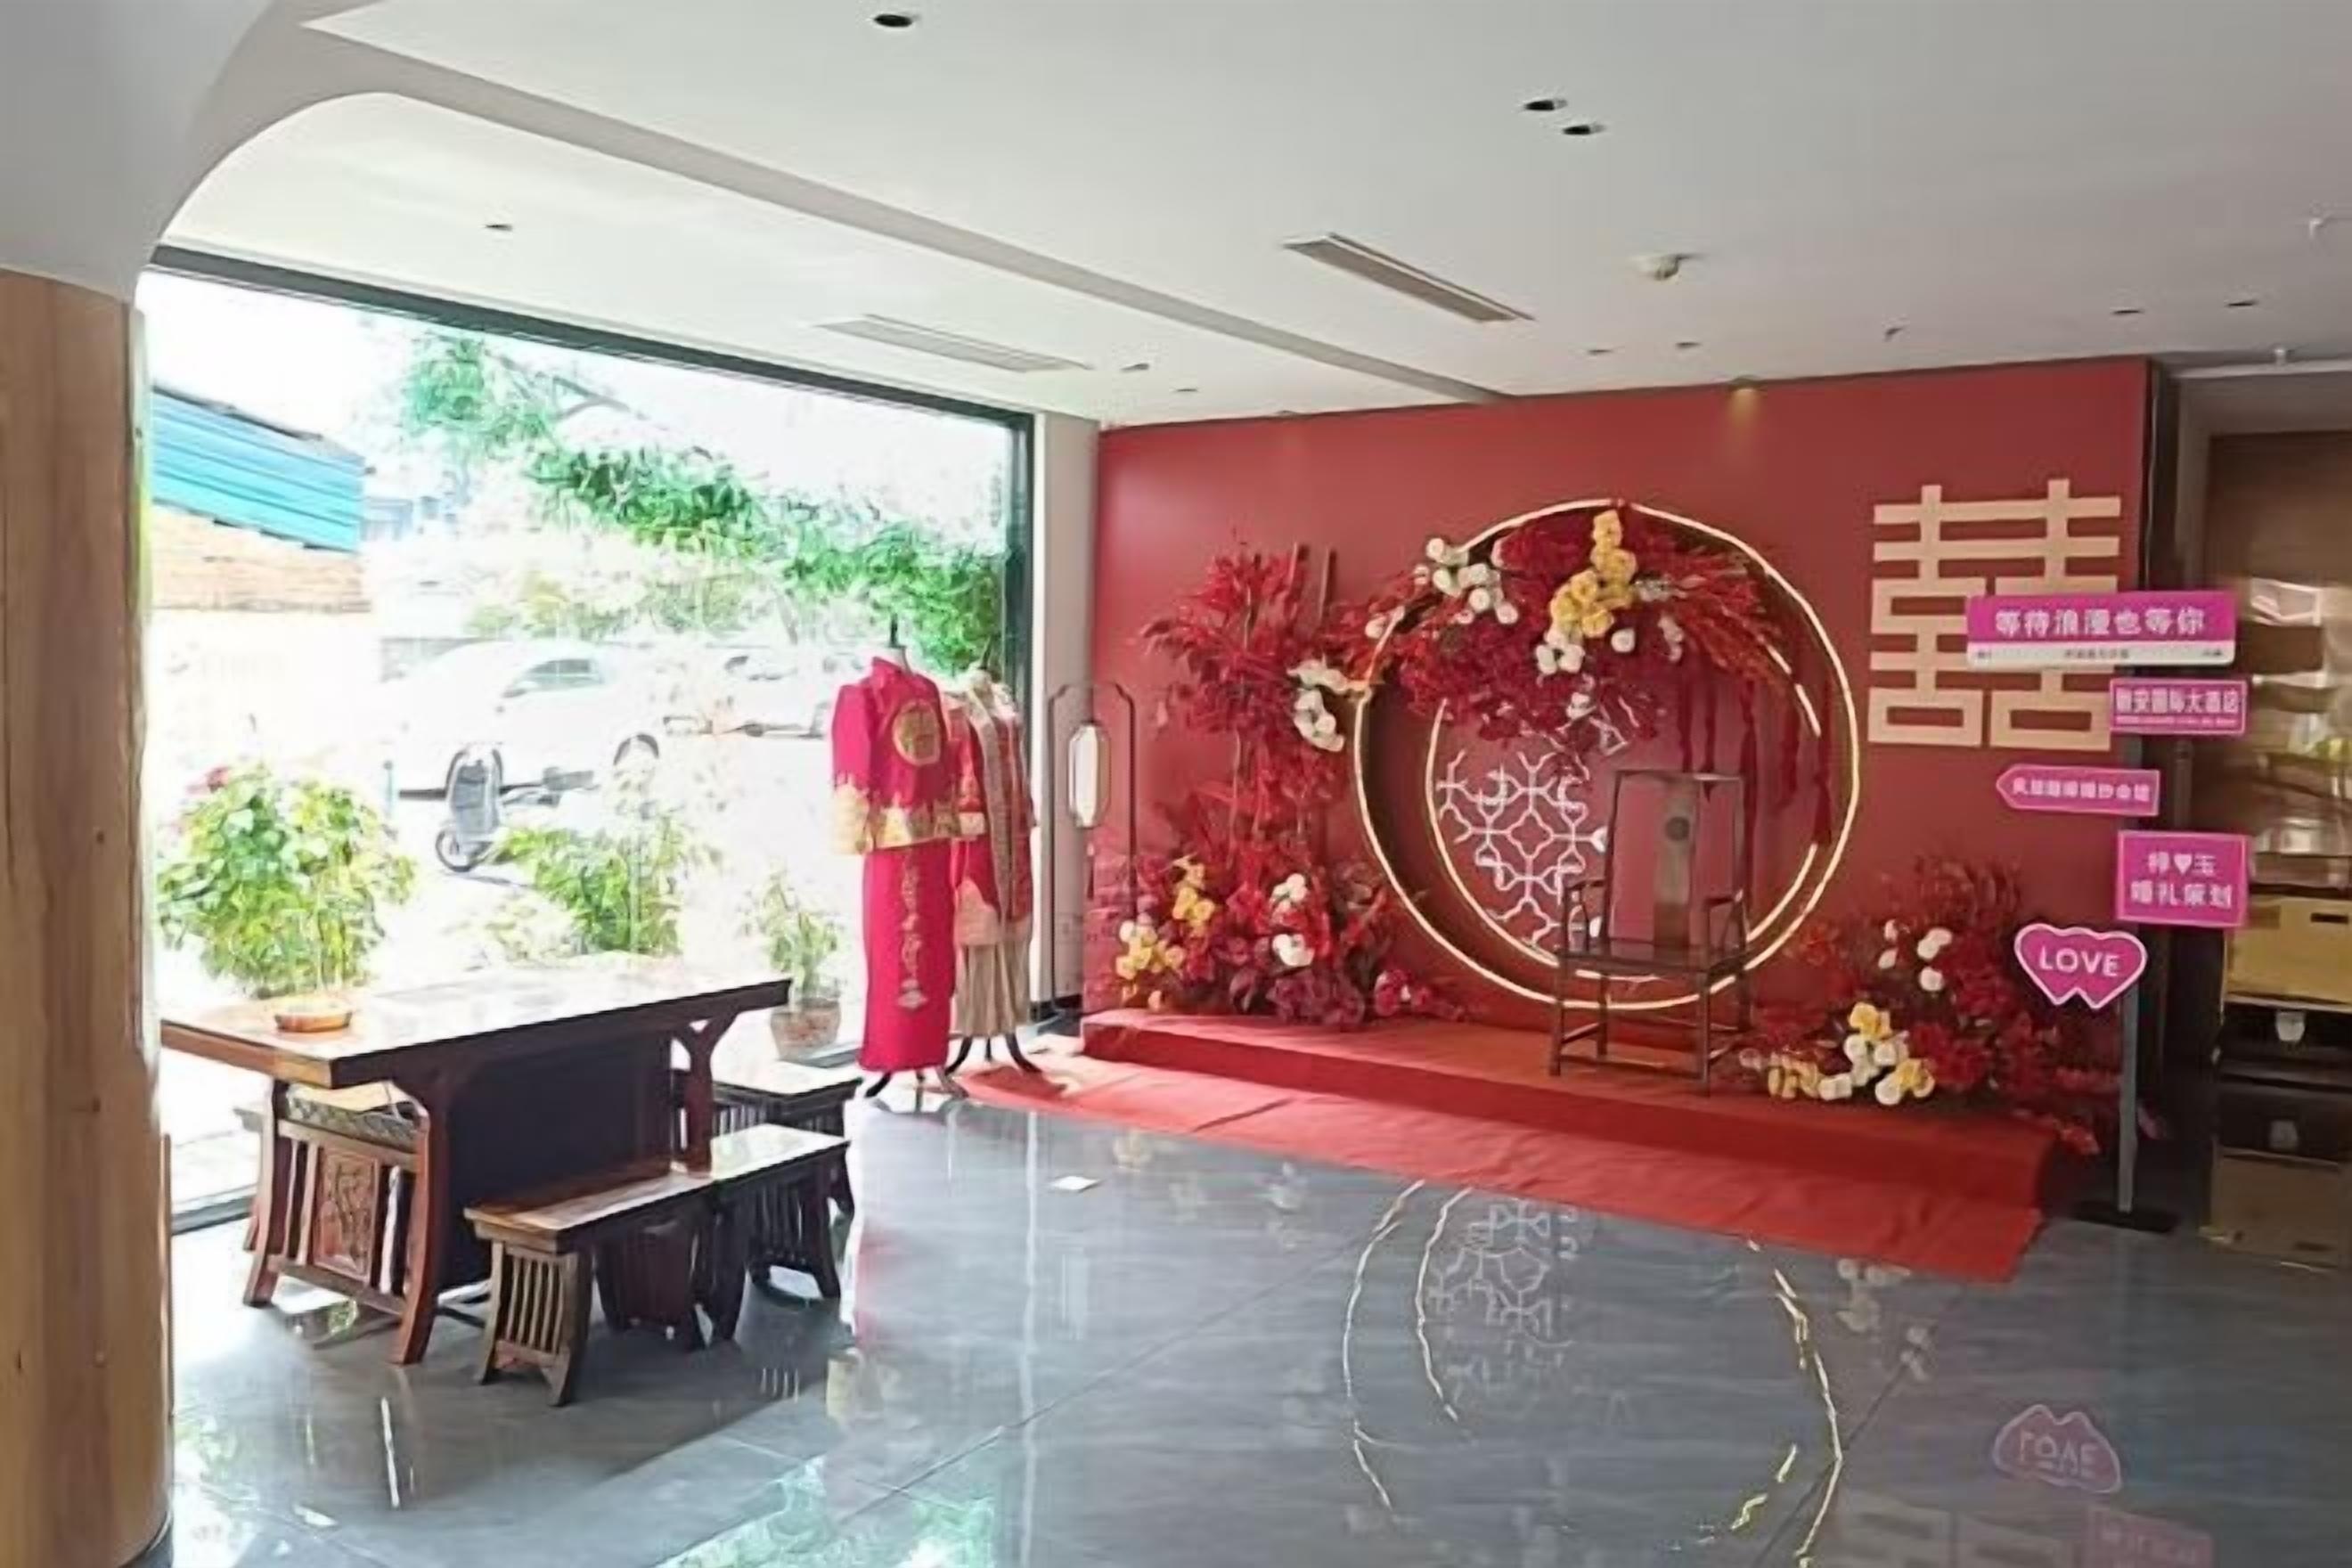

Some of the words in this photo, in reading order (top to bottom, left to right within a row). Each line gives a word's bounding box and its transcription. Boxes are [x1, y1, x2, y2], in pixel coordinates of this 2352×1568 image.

[1995, 606, 2206, 636] 等待浪漫也等你
[2130, 879, 2233, 910] 婚礼策划
[2038, 944, 2120, 977] LOVE
